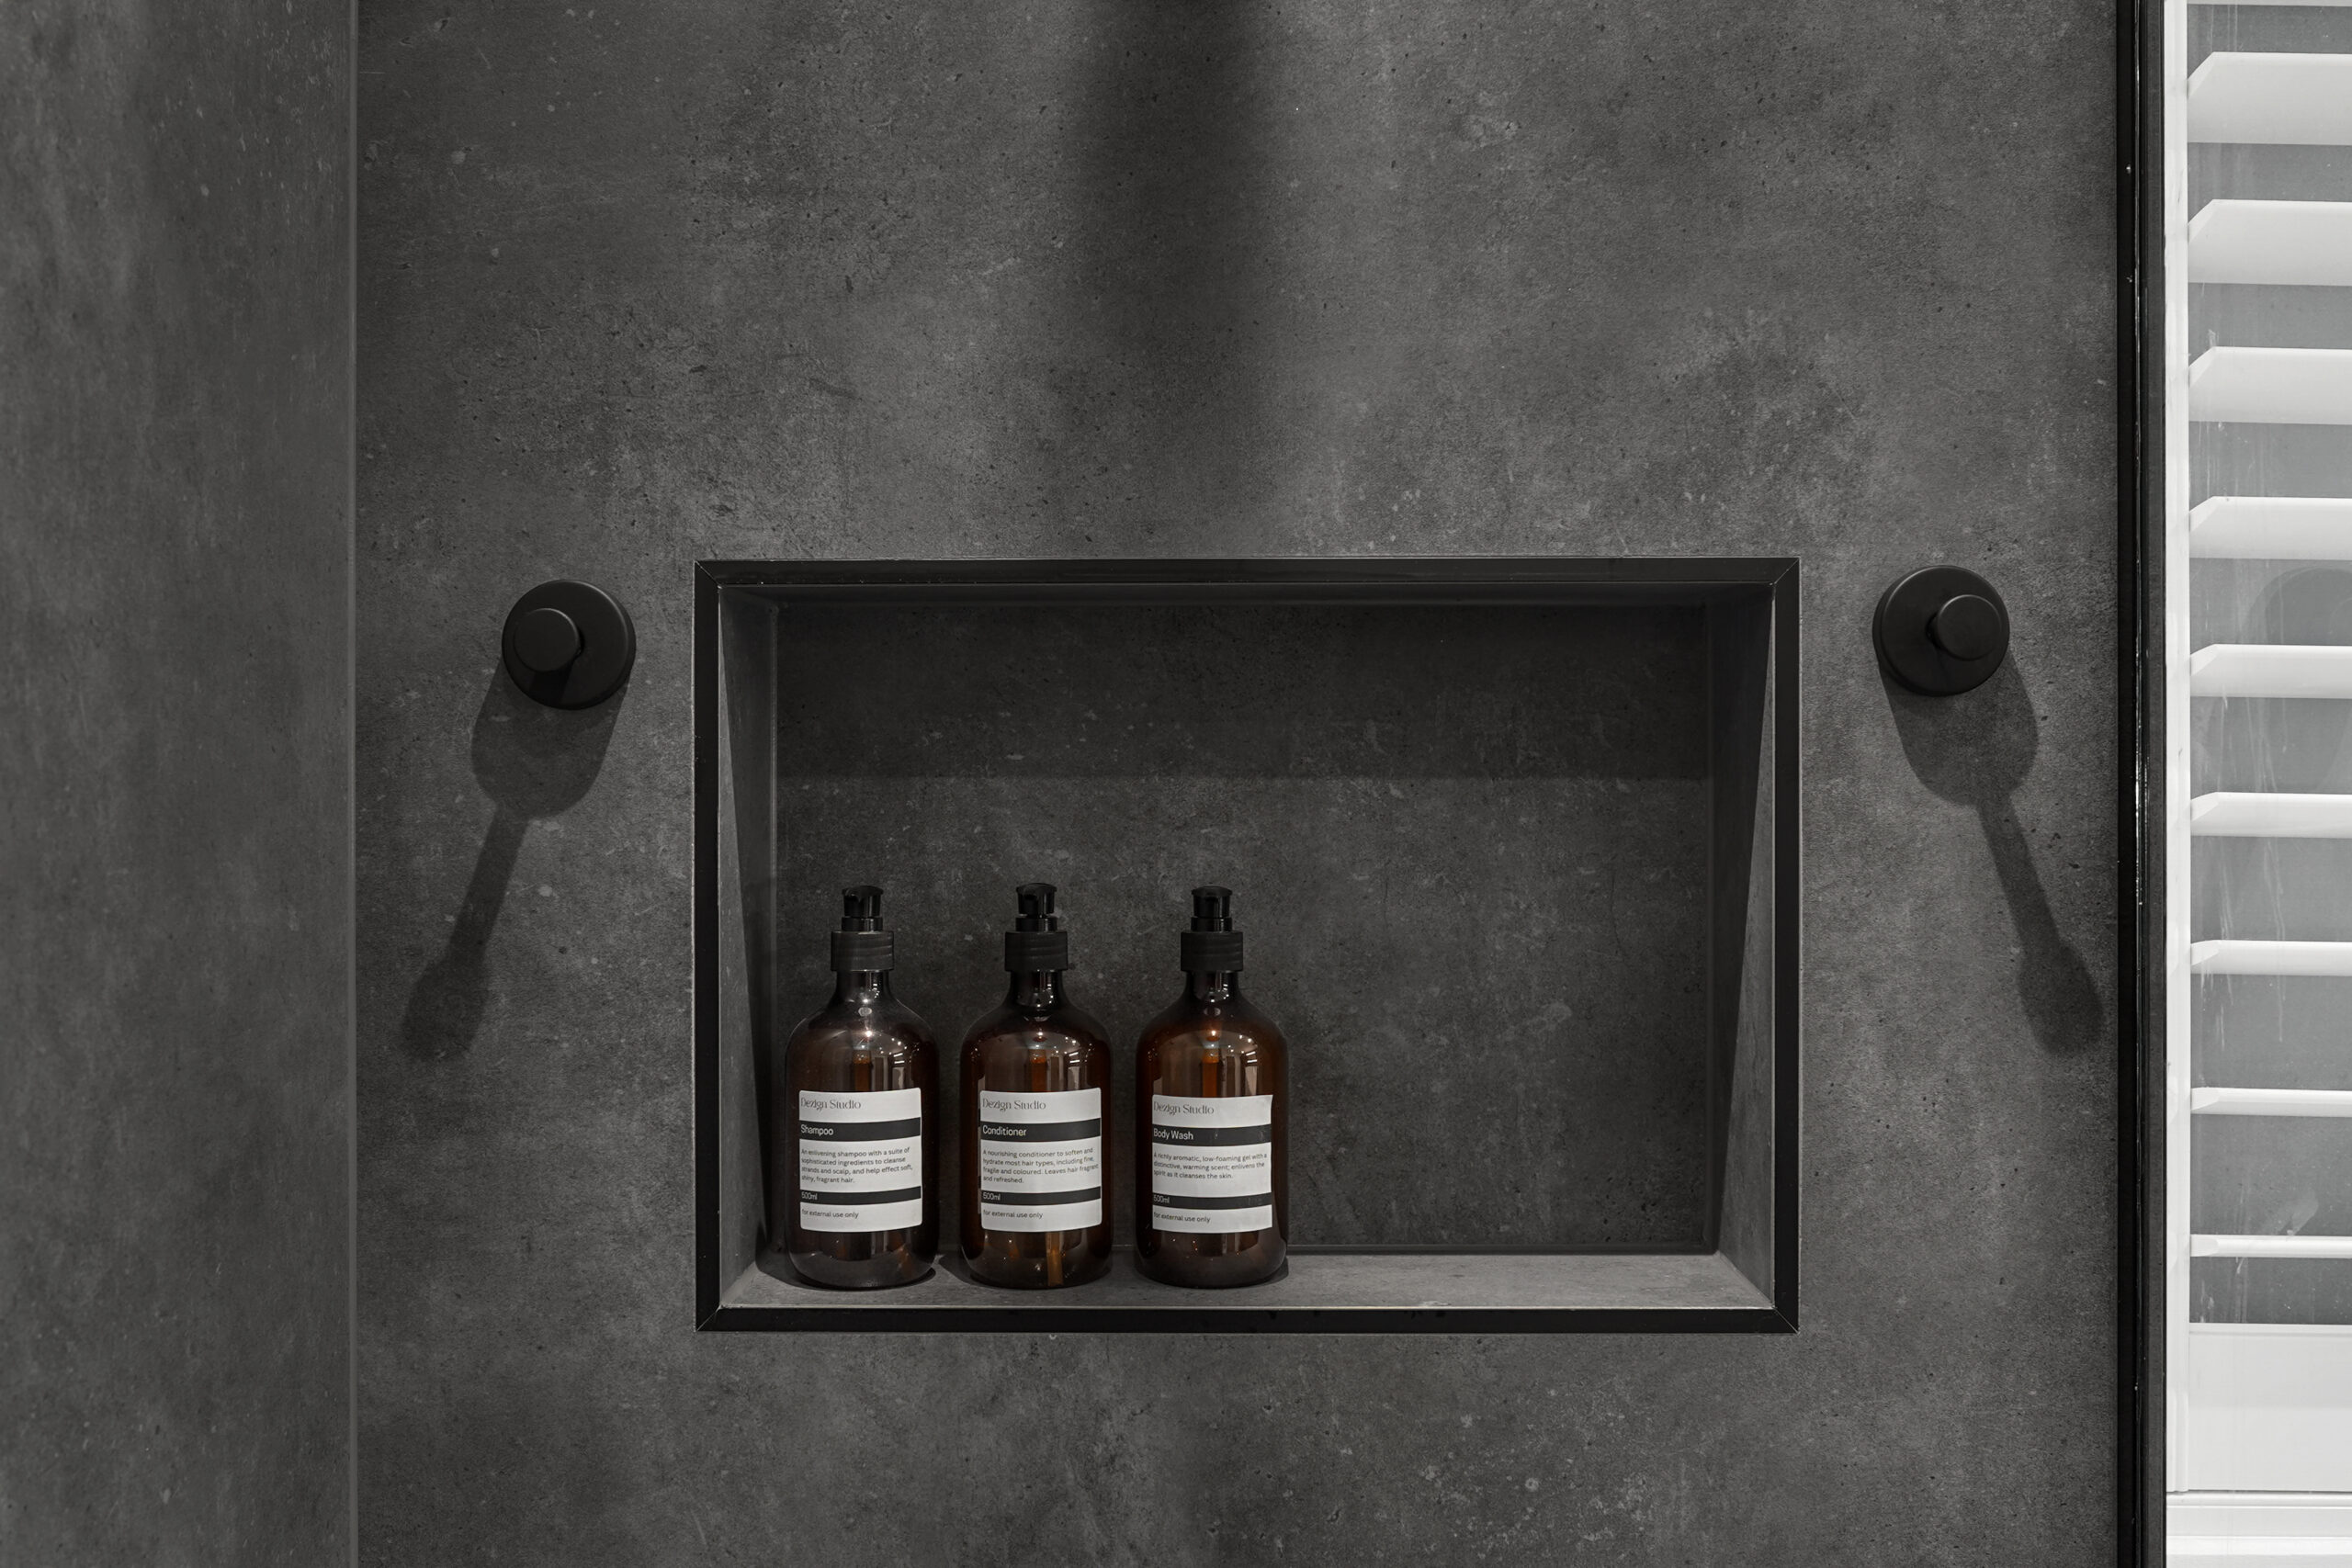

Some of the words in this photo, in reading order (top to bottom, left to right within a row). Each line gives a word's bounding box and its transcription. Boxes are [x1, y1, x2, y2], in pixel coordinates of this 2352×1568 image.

[829, 1099, 861, 1109] Studio
[1014, 1100, 1046, 1110] Studio
[1183, 1104, 1214, 1114] Studio
[801, 1124, 833, 1136] Shampoo
[983, 1125, 1026, 1136] Conditioner
[1154, 1128, 1169, 1139] Body
[1171, 1130, 1194, 1140] Wash
[808, 1150, 836, 1158] enlivening
[983, 1192, 1000, 1200] 500ml
